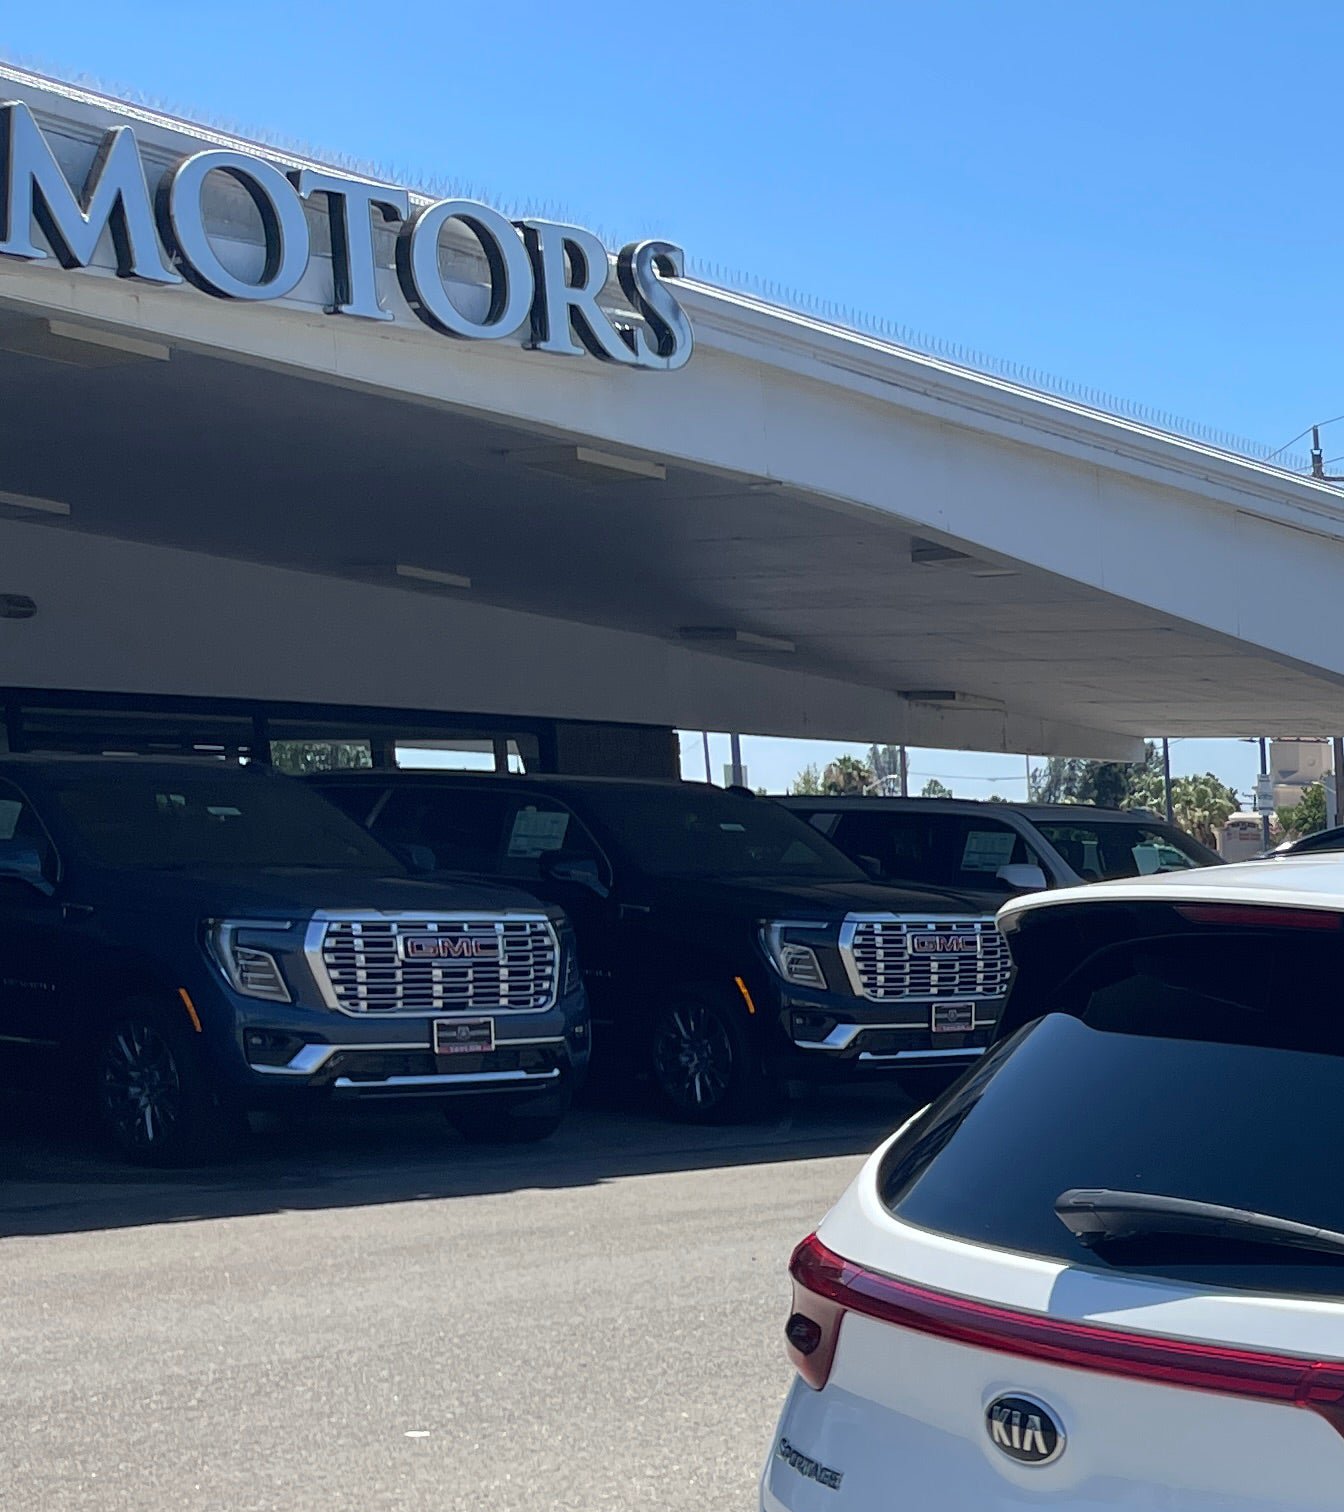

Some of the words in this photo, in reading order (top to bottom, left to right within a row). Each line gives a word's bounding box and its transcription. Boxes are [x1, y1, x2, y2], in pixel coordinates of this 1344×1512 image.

[0, 98, 696, 371] MOTORS
[407, 938, 499, 957] GMC
[913, 936, 977, 952] GMC
[990, 1404, 1049, 1455] KIA
